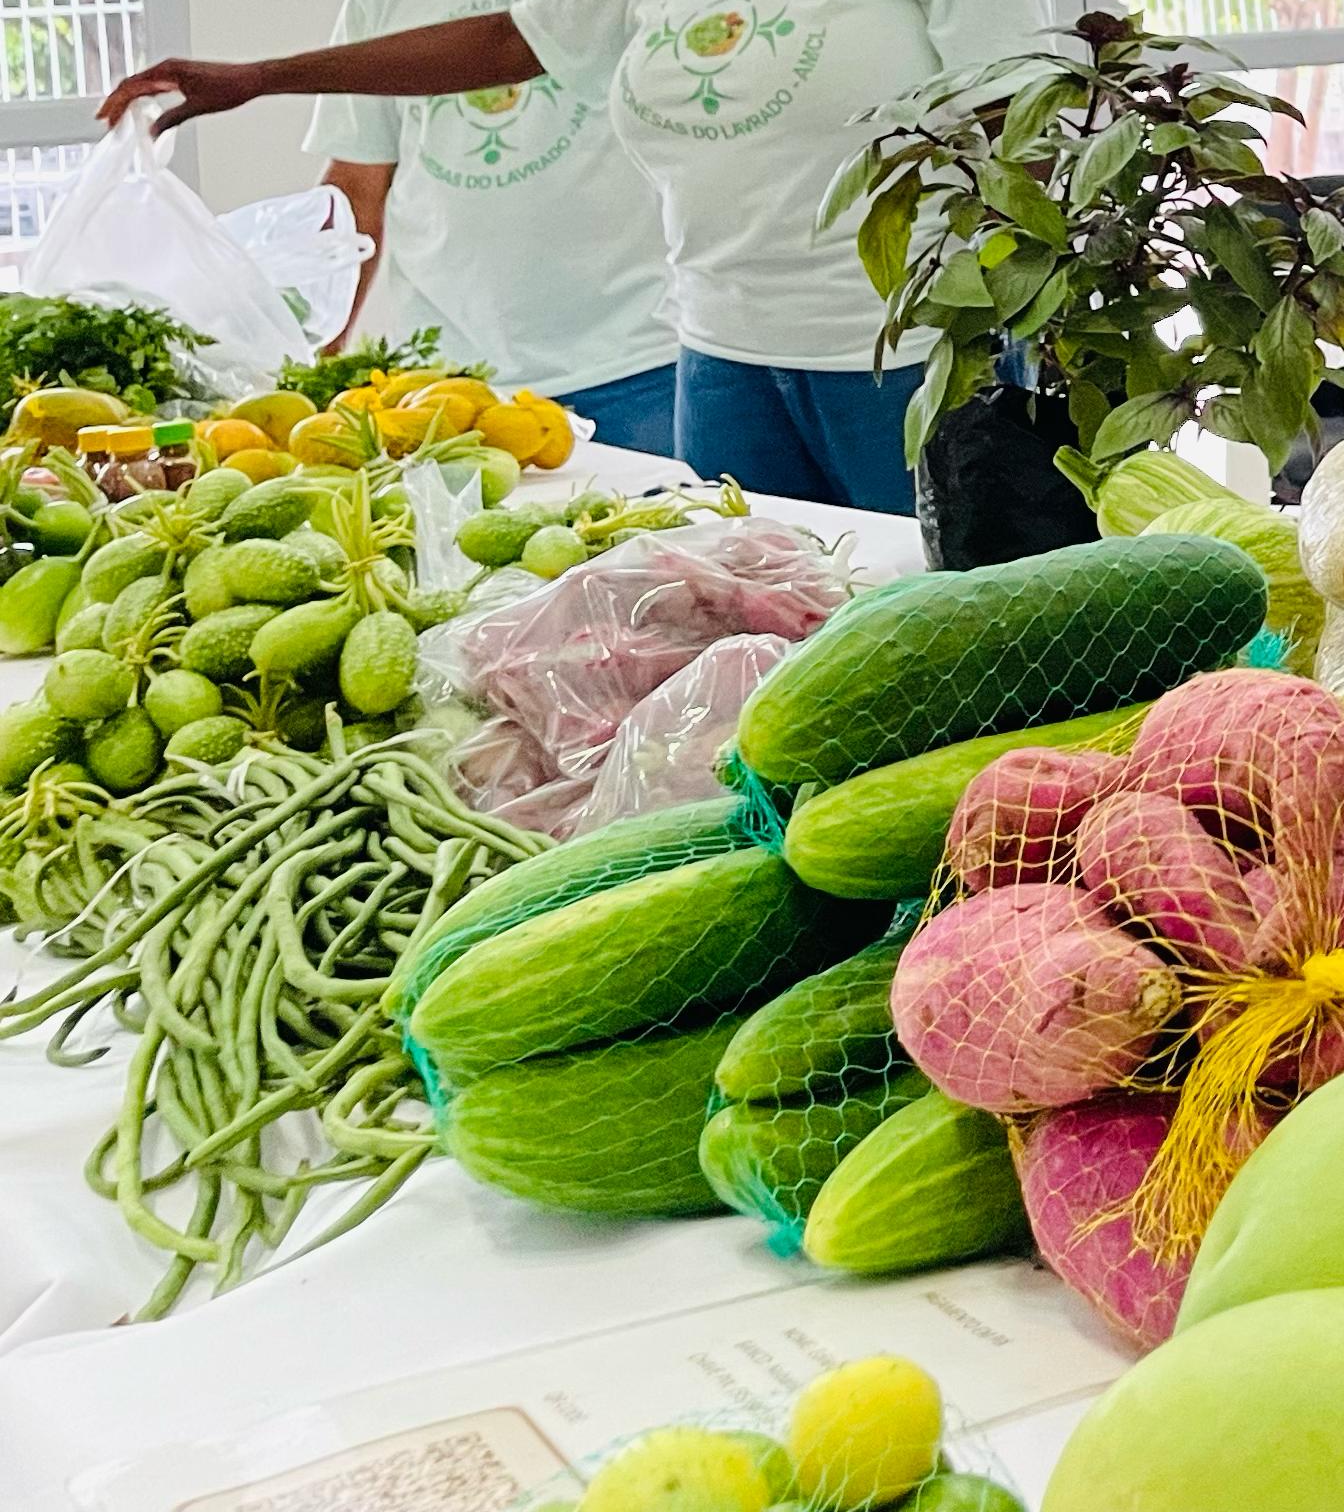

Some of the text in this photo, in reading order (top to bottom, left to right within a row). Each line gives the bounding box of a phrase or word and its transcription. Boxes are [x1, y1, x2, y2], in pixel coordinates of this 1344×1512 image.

[693, 125, 719, 141] DO
[722, 87, 794, 141] LAVRADO
[792, 25, 828, 82] AMCL
[465, 175, 492, 190] DO
[496, 136, 572, 189] LAVRADO
